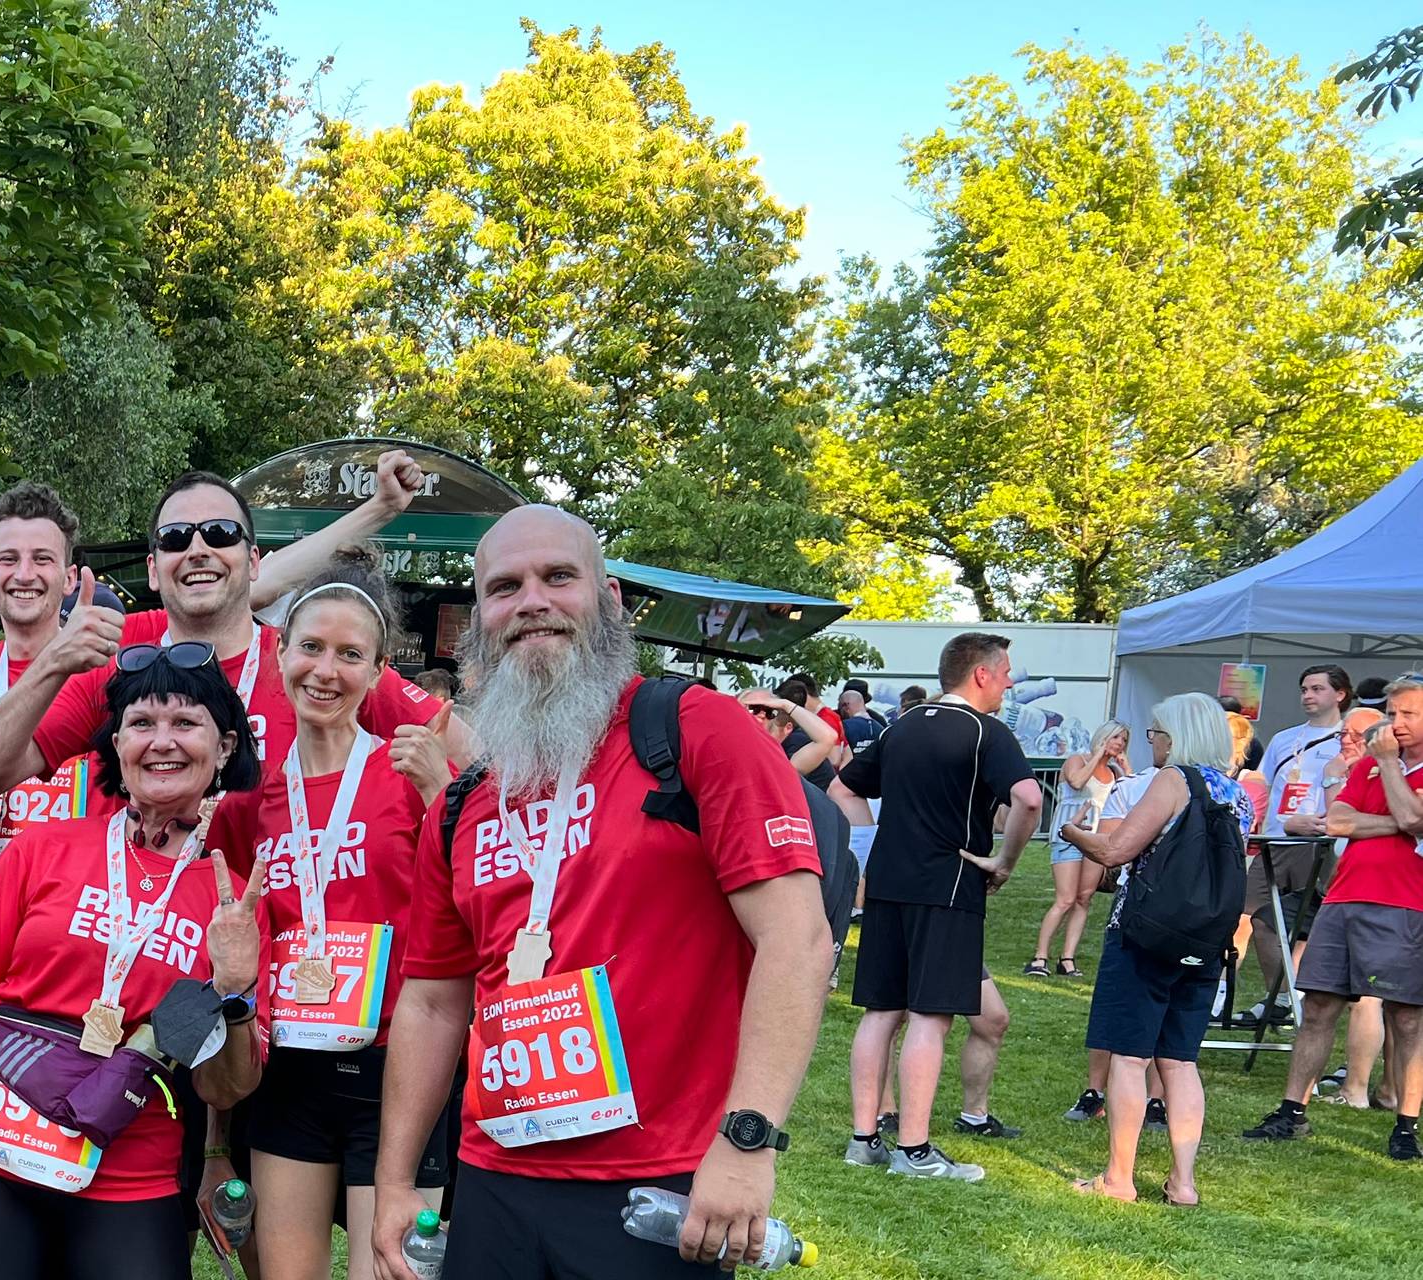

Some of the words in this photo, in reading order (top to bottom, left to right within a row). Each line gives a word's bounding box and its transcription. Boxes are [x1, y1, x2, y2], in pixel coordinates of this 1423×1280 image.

[338, 463, 441, 499] Star.
[45, 777, 71, 787] 022
[475, 783, 595, 855] RADO
[256, 821, 366, 863] RADO
[474, 817, 592, 886] ESN
[68, 910, 197, 975] ESEN
[296, 931, 367, 944] Fienlauf
[329, 945, 363, 958] 2022
[269, 961, 363, 1003] 597
[301, 1009, 335, 1020] Essen
[483, 1001, 503, 1021] E.ON
[504, 983, 579, 1013] Firmenlauf
[501, 1015, 539, 1032] Essen
[542, 1003, 583, 1023] 2022
[481, 1026, 597, 1092] 5918
[504, 1096, 535, 1111] Radio
[538, 1088, 579, 1104] Essen
[22, 1134, 57, 1152] Essen
